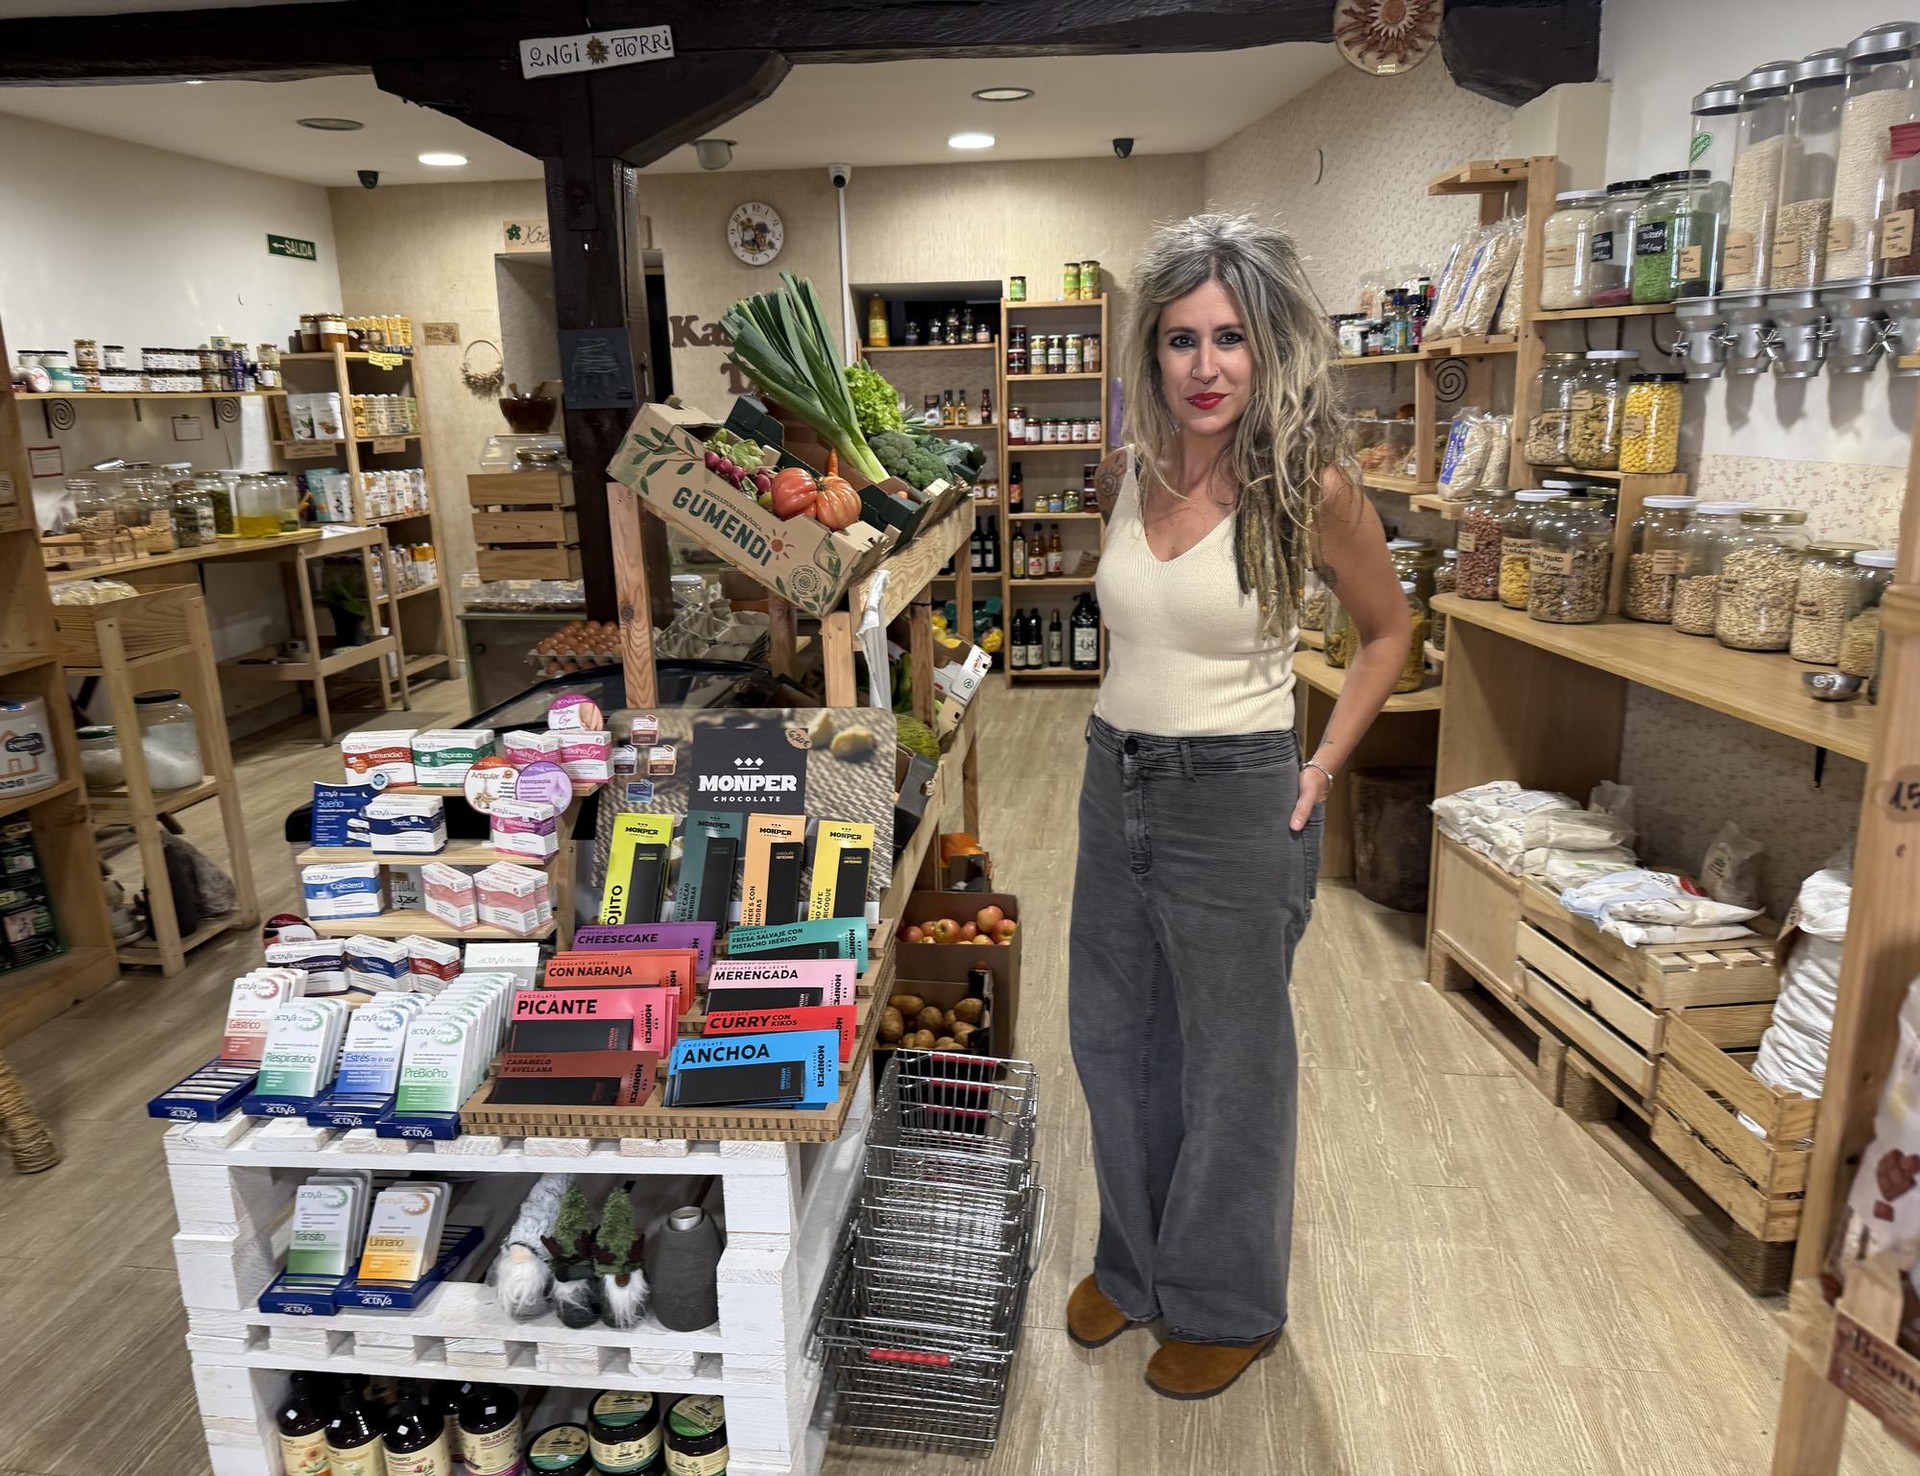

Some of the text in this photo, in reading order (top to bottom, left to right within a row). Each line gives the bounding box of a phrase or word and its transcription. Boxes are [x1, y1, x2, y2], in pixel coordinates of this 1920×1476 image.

[284, 239, 314, 258] SALIDA
[672, 486, 773, 567] GUMENDI
[368, 751, 404, 759] Inmunidad
[436, 751, 474, 760] Respiratorio
[471, 772, 501, 780] Articular
[698, 774, 798, 792] MONPER
[317, 799, 345, 808] Sueño
[391, 819, 411, 827] Sueño
[698, 820, 731, 830] MONPER
[625, 826, 659, 836] MONPER
[759, 827, 792, 836] MONPER
[829, 831, 862, 841] MONPER
[330, 881, 365, 890] Colesterol
[607, 884, 623, 925] OJITO
[687, 886, 698, 921] MENDRAS
[823, 887, 832, 919] RICOQUE
[754, 898, 762, 926] ENDRAS
[577, 933, 659, 944] CHEESECAKE
[731, 928, 804, 944] FRESA SALVAJE CON
[731, 935, 798, 950] PISTACHO IBÉRICO
[549, 966, 633, 977] CON NARANJA
[713, 969, 798, 981] MERENGADA
[833, 974, 842, 1006] MONPE
[516, 999, 598, 1015] PICANTE
[710, 1015, 772, 1030] CURRY
[265, 1052, 317, 1064] Respiratorio
[344, 1053, 370, 1063] Estrés
[682, 1042, 770, 1065] ANCHOA
[817, 1045, 825, 1088] MONPER
[404, 1067, 448, 1079] PreBioPro
[629, 1063, 644, 1104] MONPER
[369, 1237, 405, 1247] Urinario
